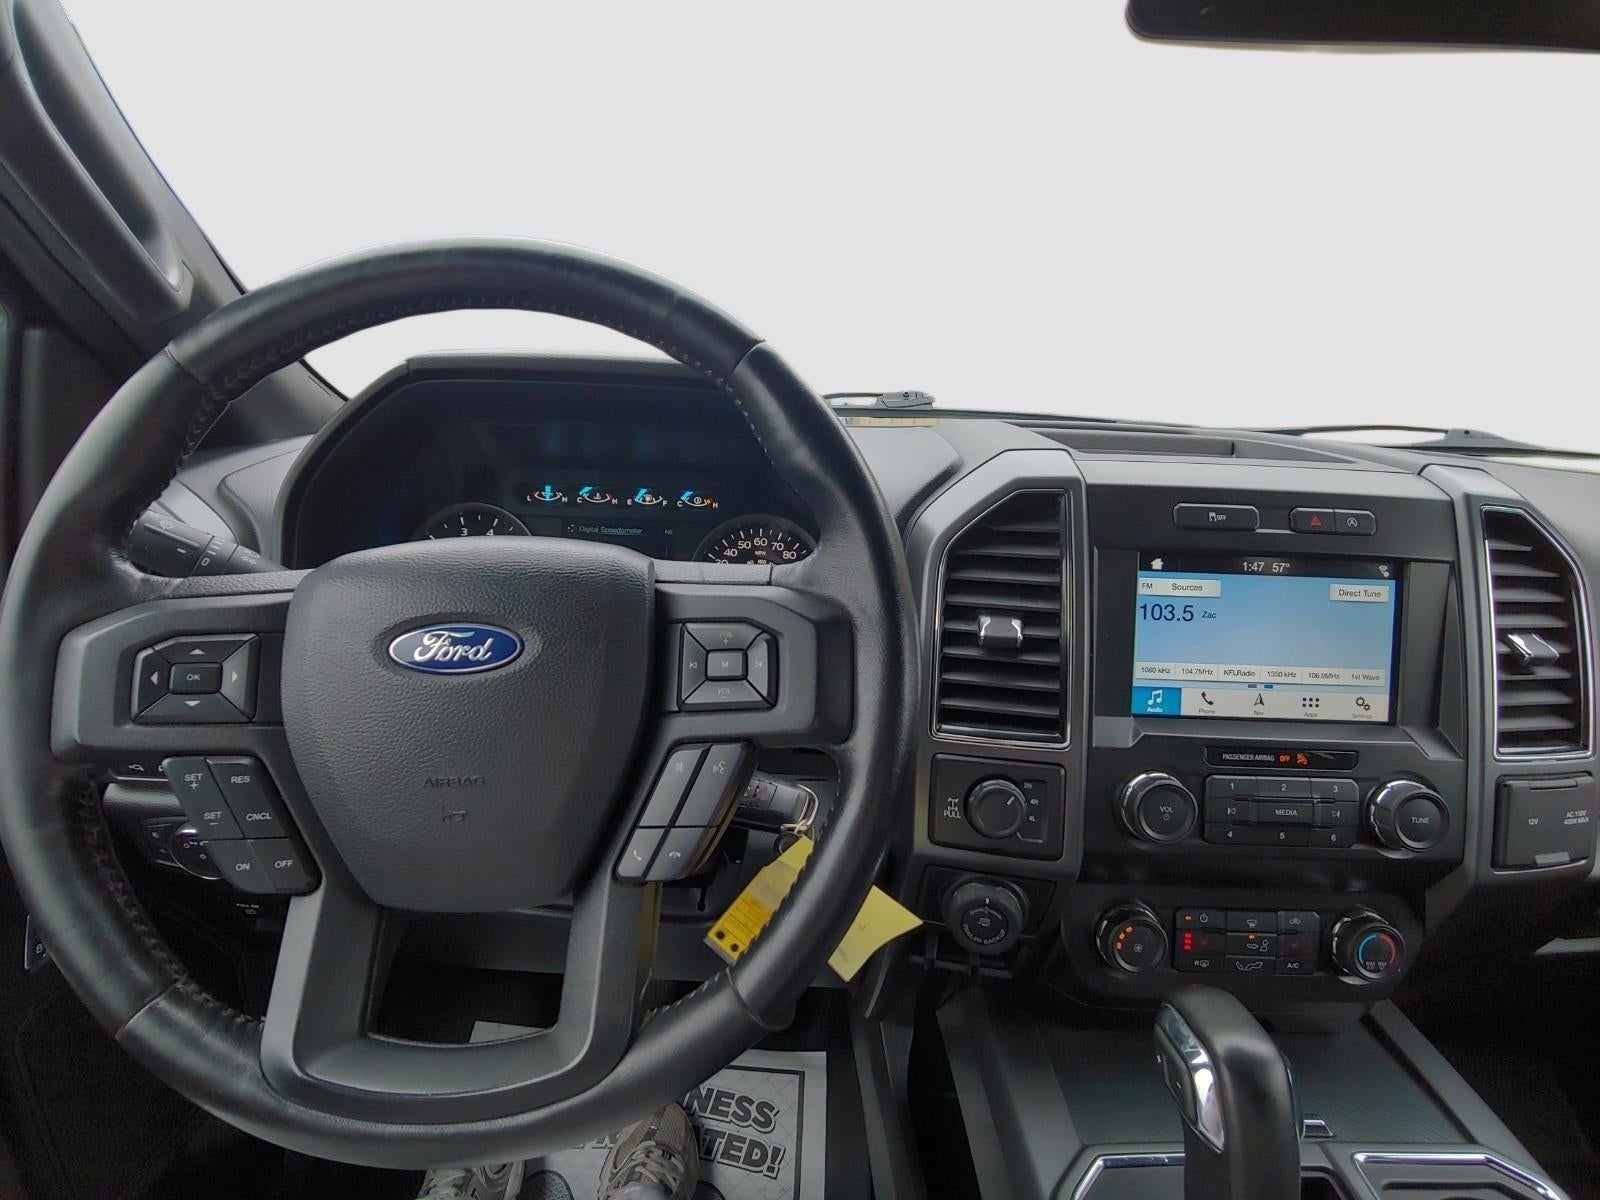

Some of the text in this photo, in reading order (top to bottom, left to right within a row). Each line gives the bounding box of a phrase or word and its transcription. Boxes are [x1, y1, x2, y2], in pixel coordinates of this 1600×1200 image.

[460, 528, 468, 536] 3
[578, 525, 643, 535] Digital Speedometer
[738, 541, 751, 549] 50
[754, 538, 767, 546] 60
[771, 542, 784, 551] 70
[723, 548, 738, 557] 40
[782, 551, 796, 559] 80
[1243, 562, 1264, 572] 1:47
[1171, 582, 1203, 591] Sources
[1338, 588, 1381, 598] Direct Tune
[1139, 603, 1194, 622] 103.5
[1201, 610, 1217, 619] Zac
[414, 630, 494, 662] Ford
[184, 774, 203, 782] SET
[230, 776, 250, 784] RES
[246, 813, 272, 821] CNCL
[944, 810, 962, 819] PULL
[236, 863, 250, 871] ON
[274, 859, 293, 869] OFF
[695, 1124, 786, 1178] TED!
